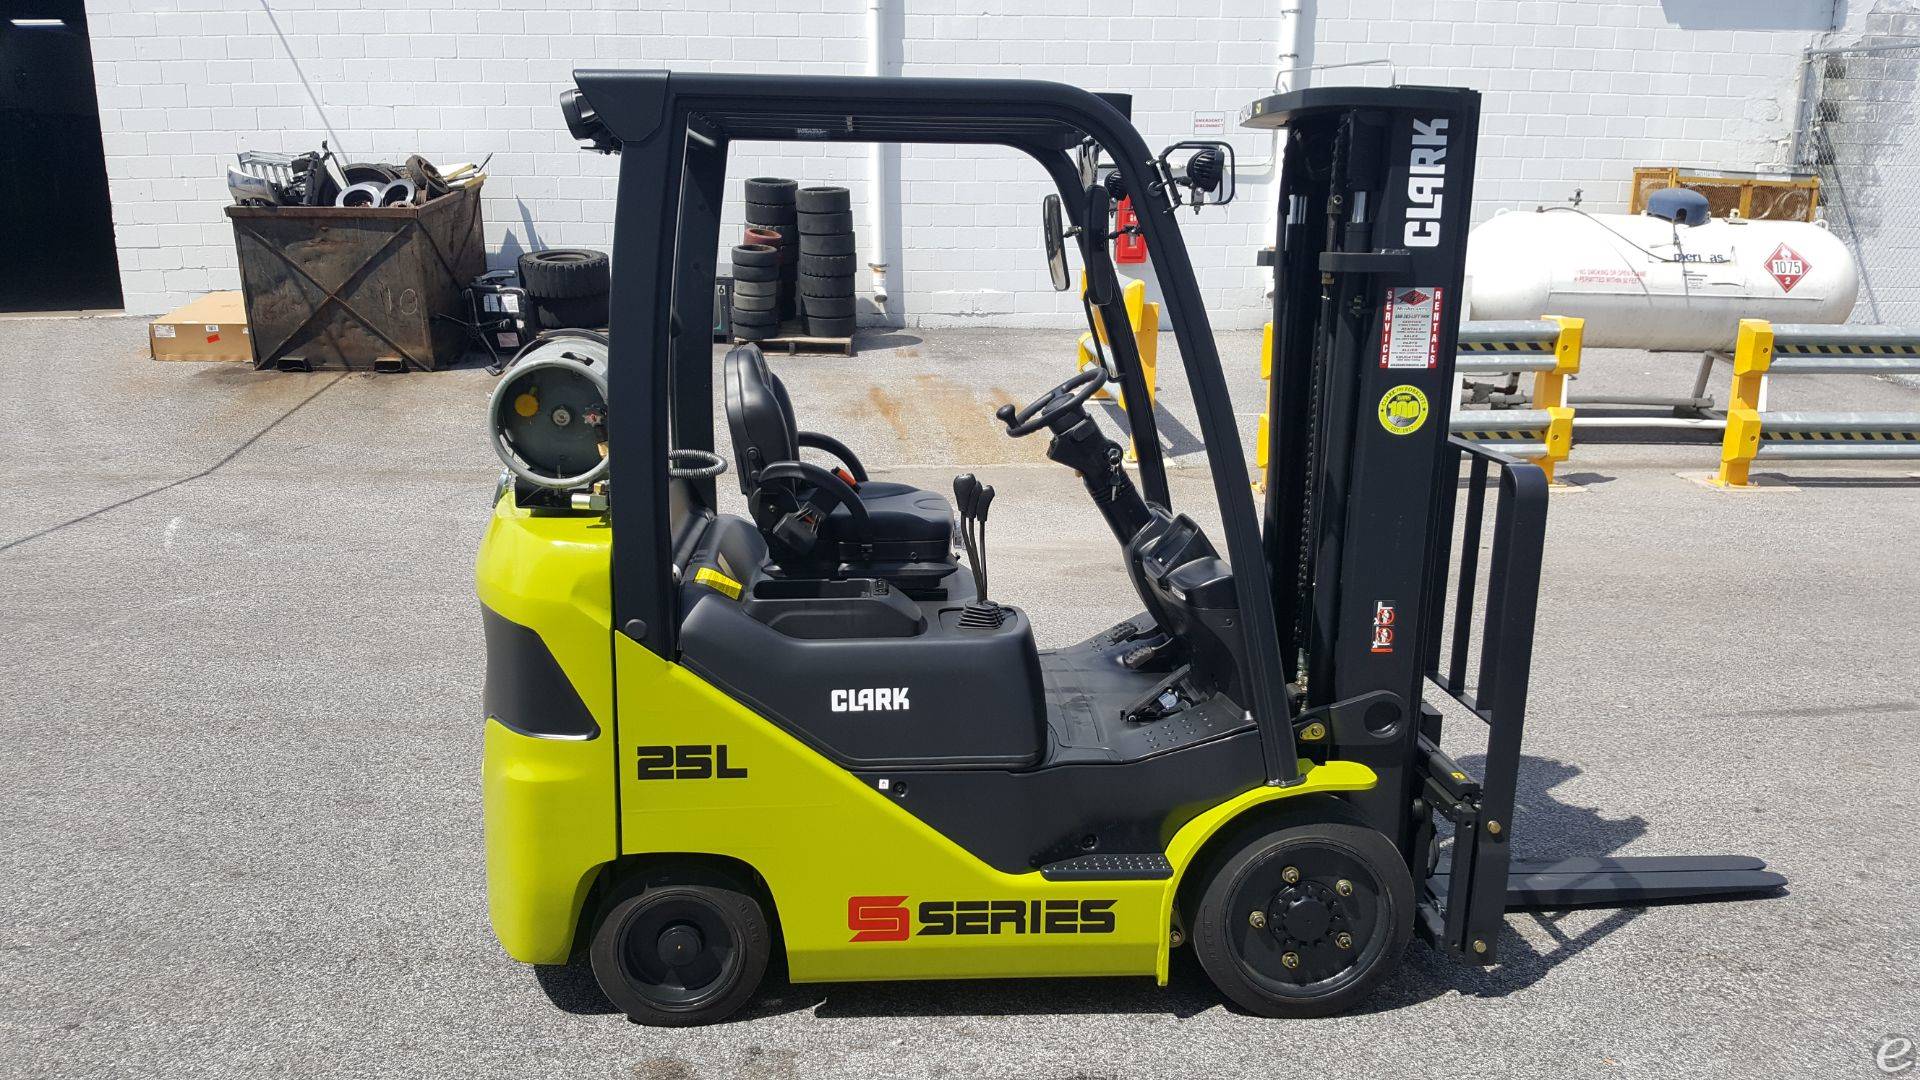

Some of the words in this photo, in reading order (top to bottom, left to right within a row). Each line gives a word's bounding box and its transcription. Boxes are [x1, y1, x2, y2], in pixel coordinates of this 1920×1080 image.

[1403, 118, 1449, 248] CLARK
[1773, 260, 1801, 274] 1075
[1784, 277, 1791, 285] 2
[1381, 290, 1393, 364] SERVICE
[1430, 290, 1441, 364] RENTALS
[1388, 400, 1419, 419] 100
[831, 687, 910, 712] CLARK
[637, 745, 748, 780] 25L
[848, 896, 910, 942] S
[916, 900, 1119, 935] SERIES
